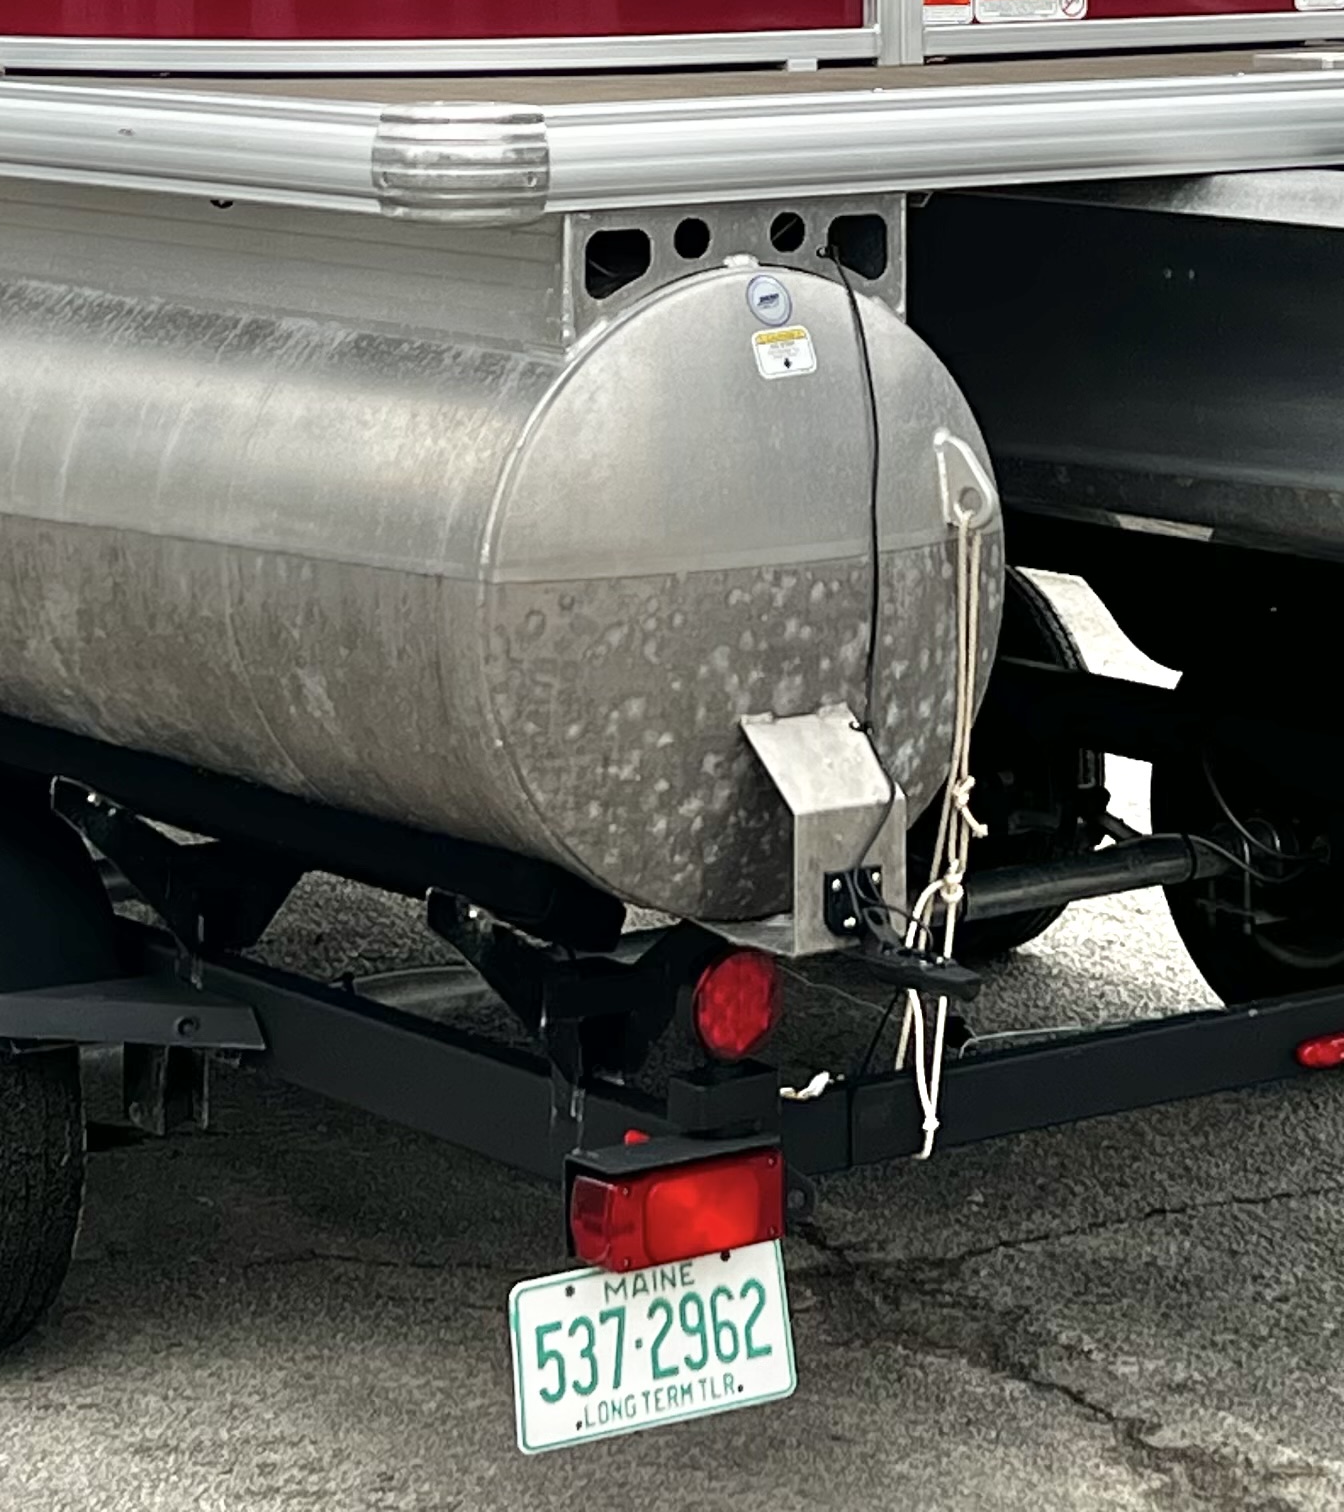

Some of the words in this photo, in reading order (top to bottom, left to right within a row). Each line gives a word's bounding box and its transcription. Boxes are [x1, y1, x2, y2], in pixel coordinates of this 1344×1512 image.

[604, 1261, 696, 1304] MAINE
[583, 1396, 637, 1428] LONG
[642, 1381, 694, 1414] TERM
[700, 1372, 735, 1403] TLR
